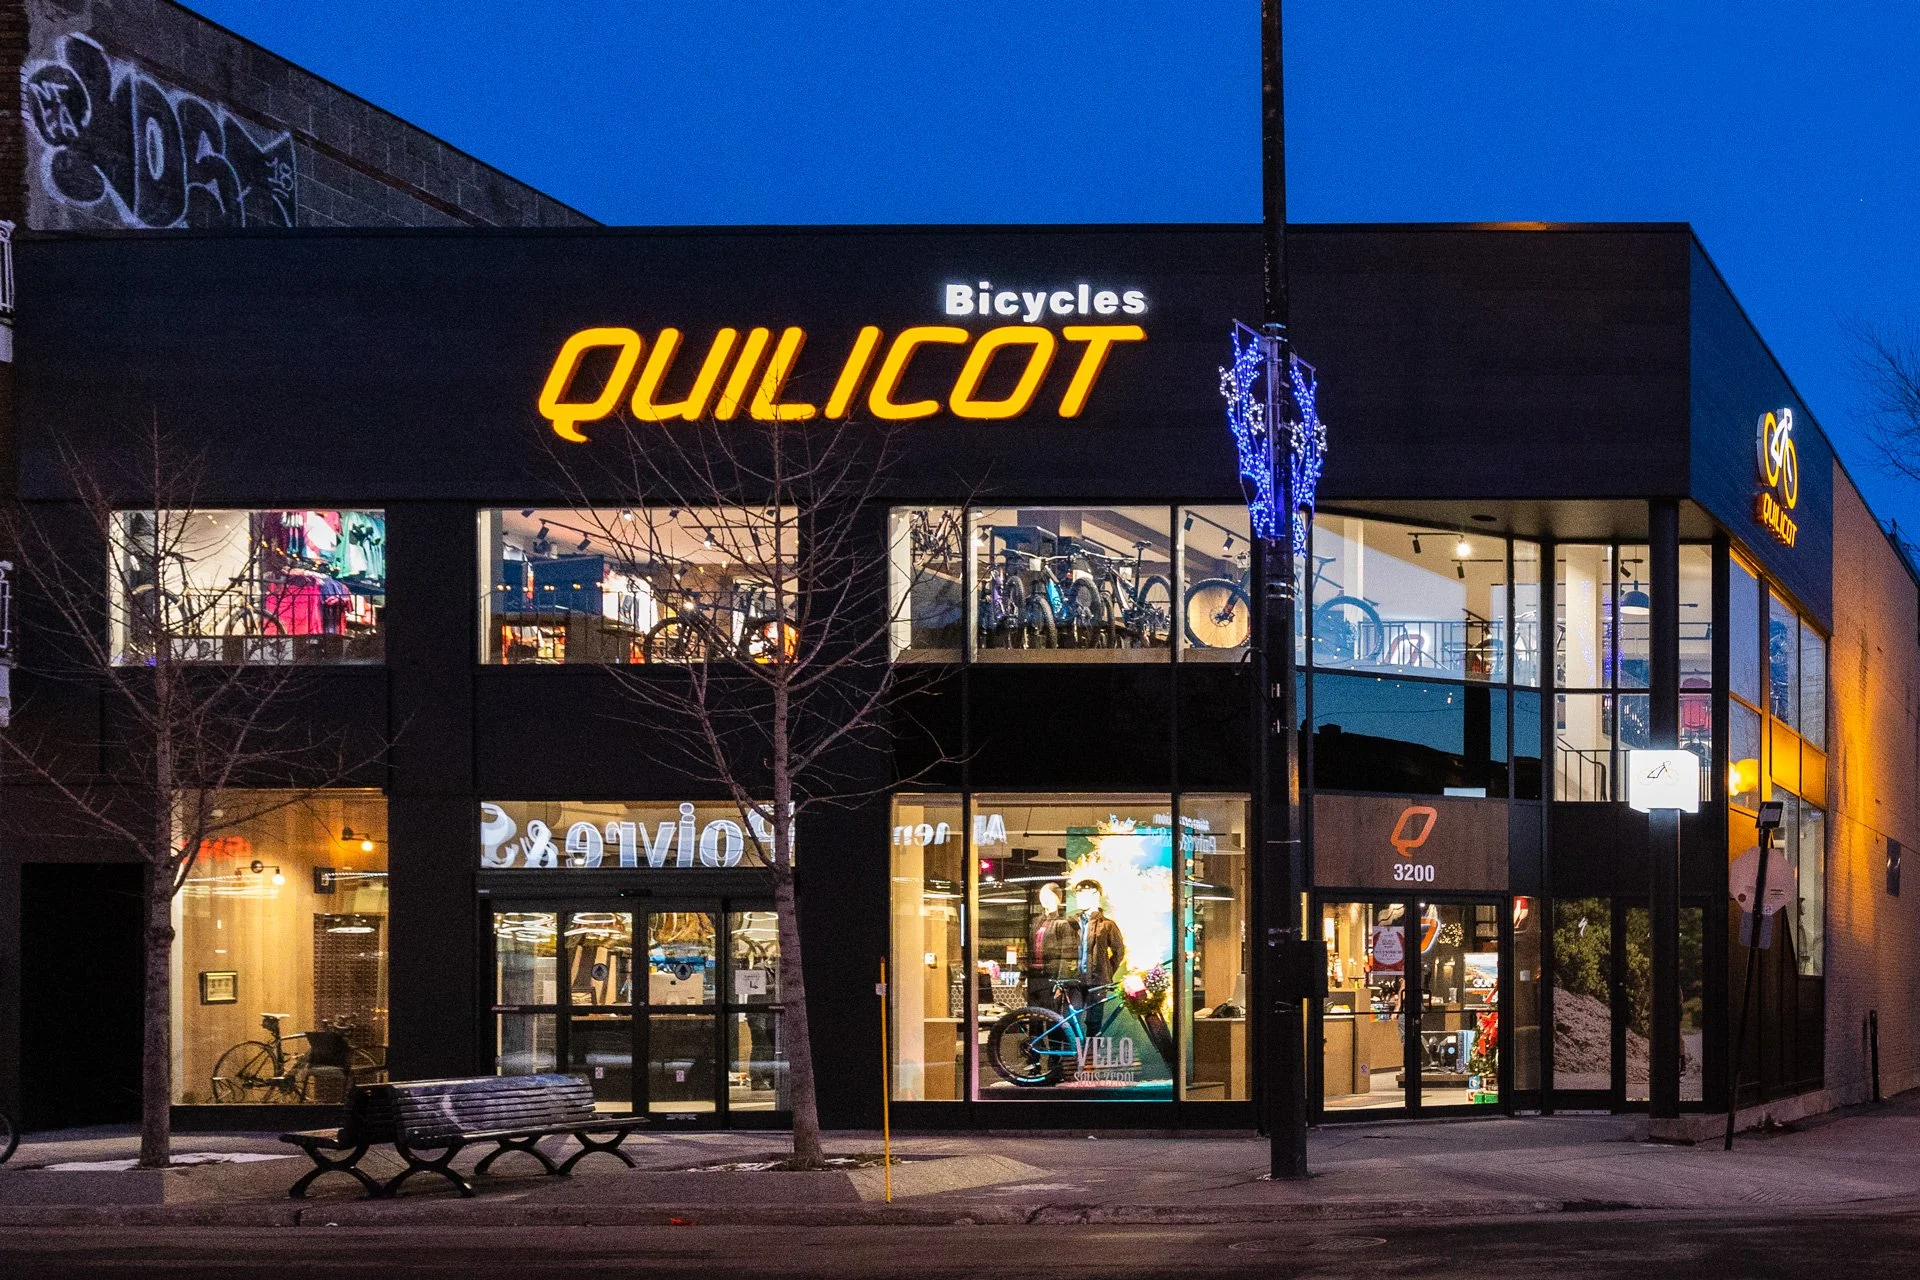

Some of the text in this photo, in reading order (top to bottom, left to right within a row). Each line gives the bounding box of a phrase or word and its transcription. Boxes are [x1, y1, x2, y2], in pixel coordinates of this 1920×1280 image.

[945, 282, 1147, 323] Bicycles
[538, 325, 1147, 442] QUILICOT
[1763, 492, 1798, 548] QUILICOT
[1393, 863, 1435, 882] 3200
